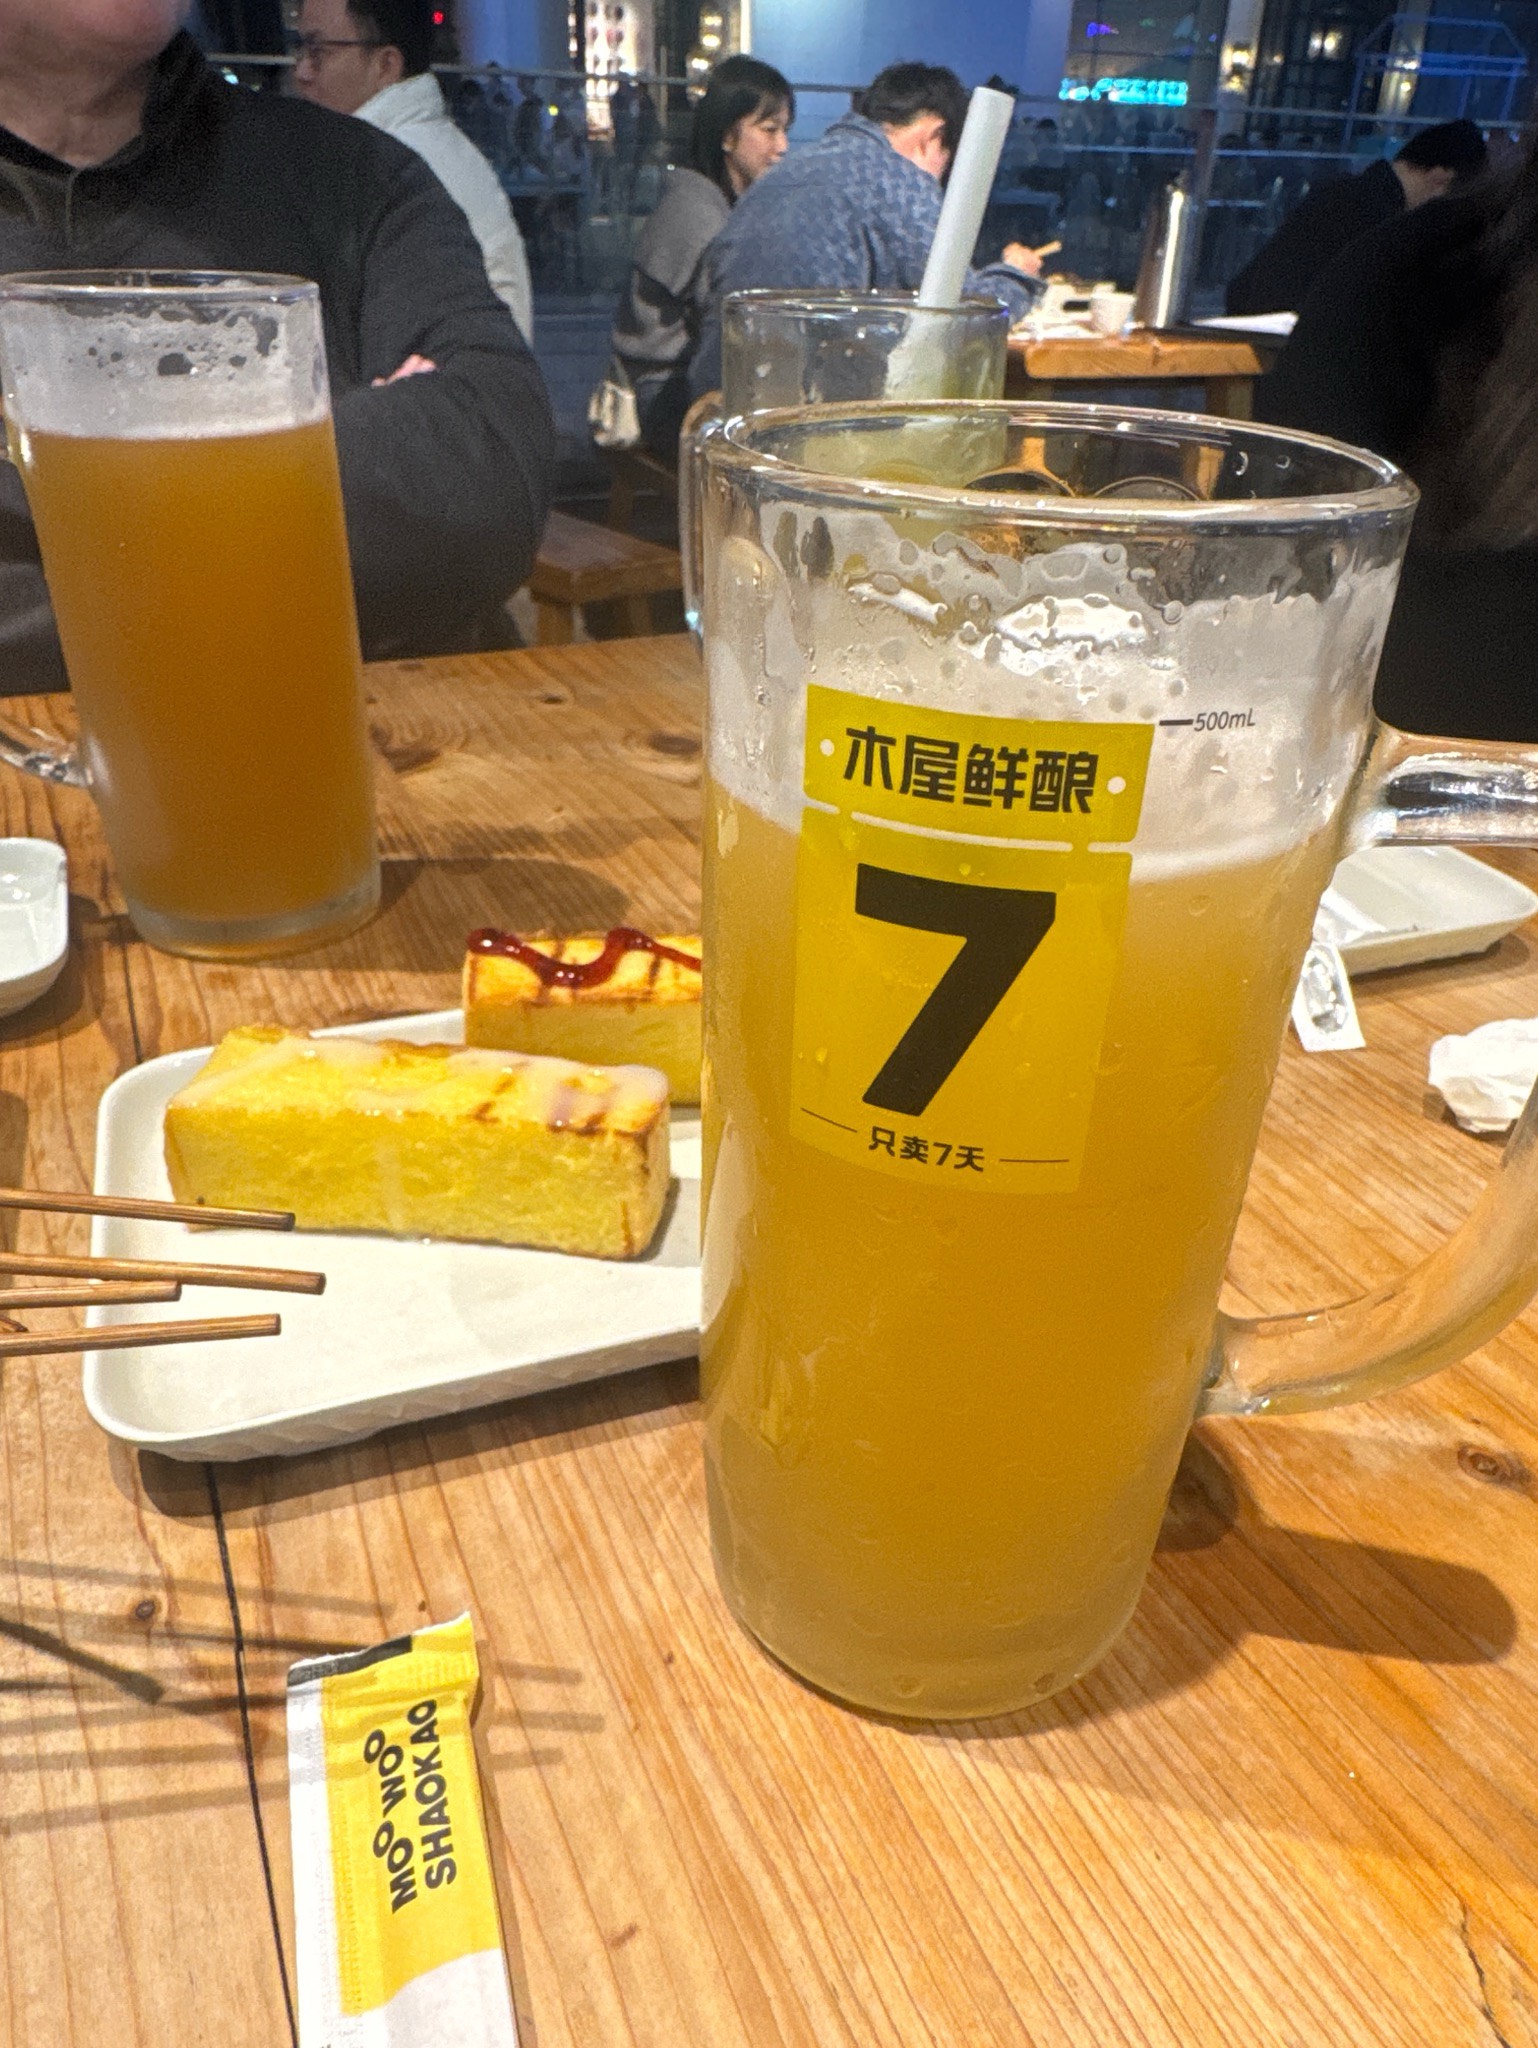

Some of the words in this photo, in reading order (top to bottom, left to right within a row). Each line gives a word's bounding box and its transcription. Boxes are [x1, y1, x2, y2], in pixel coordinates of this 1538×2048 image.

[1194, 708, 1256, 732] 500mL
[842, 725, 1099, 815] 木屋鲜酿
[854, 862, 1058, 1118] 7
[867, 1126, 986, 1173] 只卖7天
[406, 1698, 458, 1891] SHAOKAO
